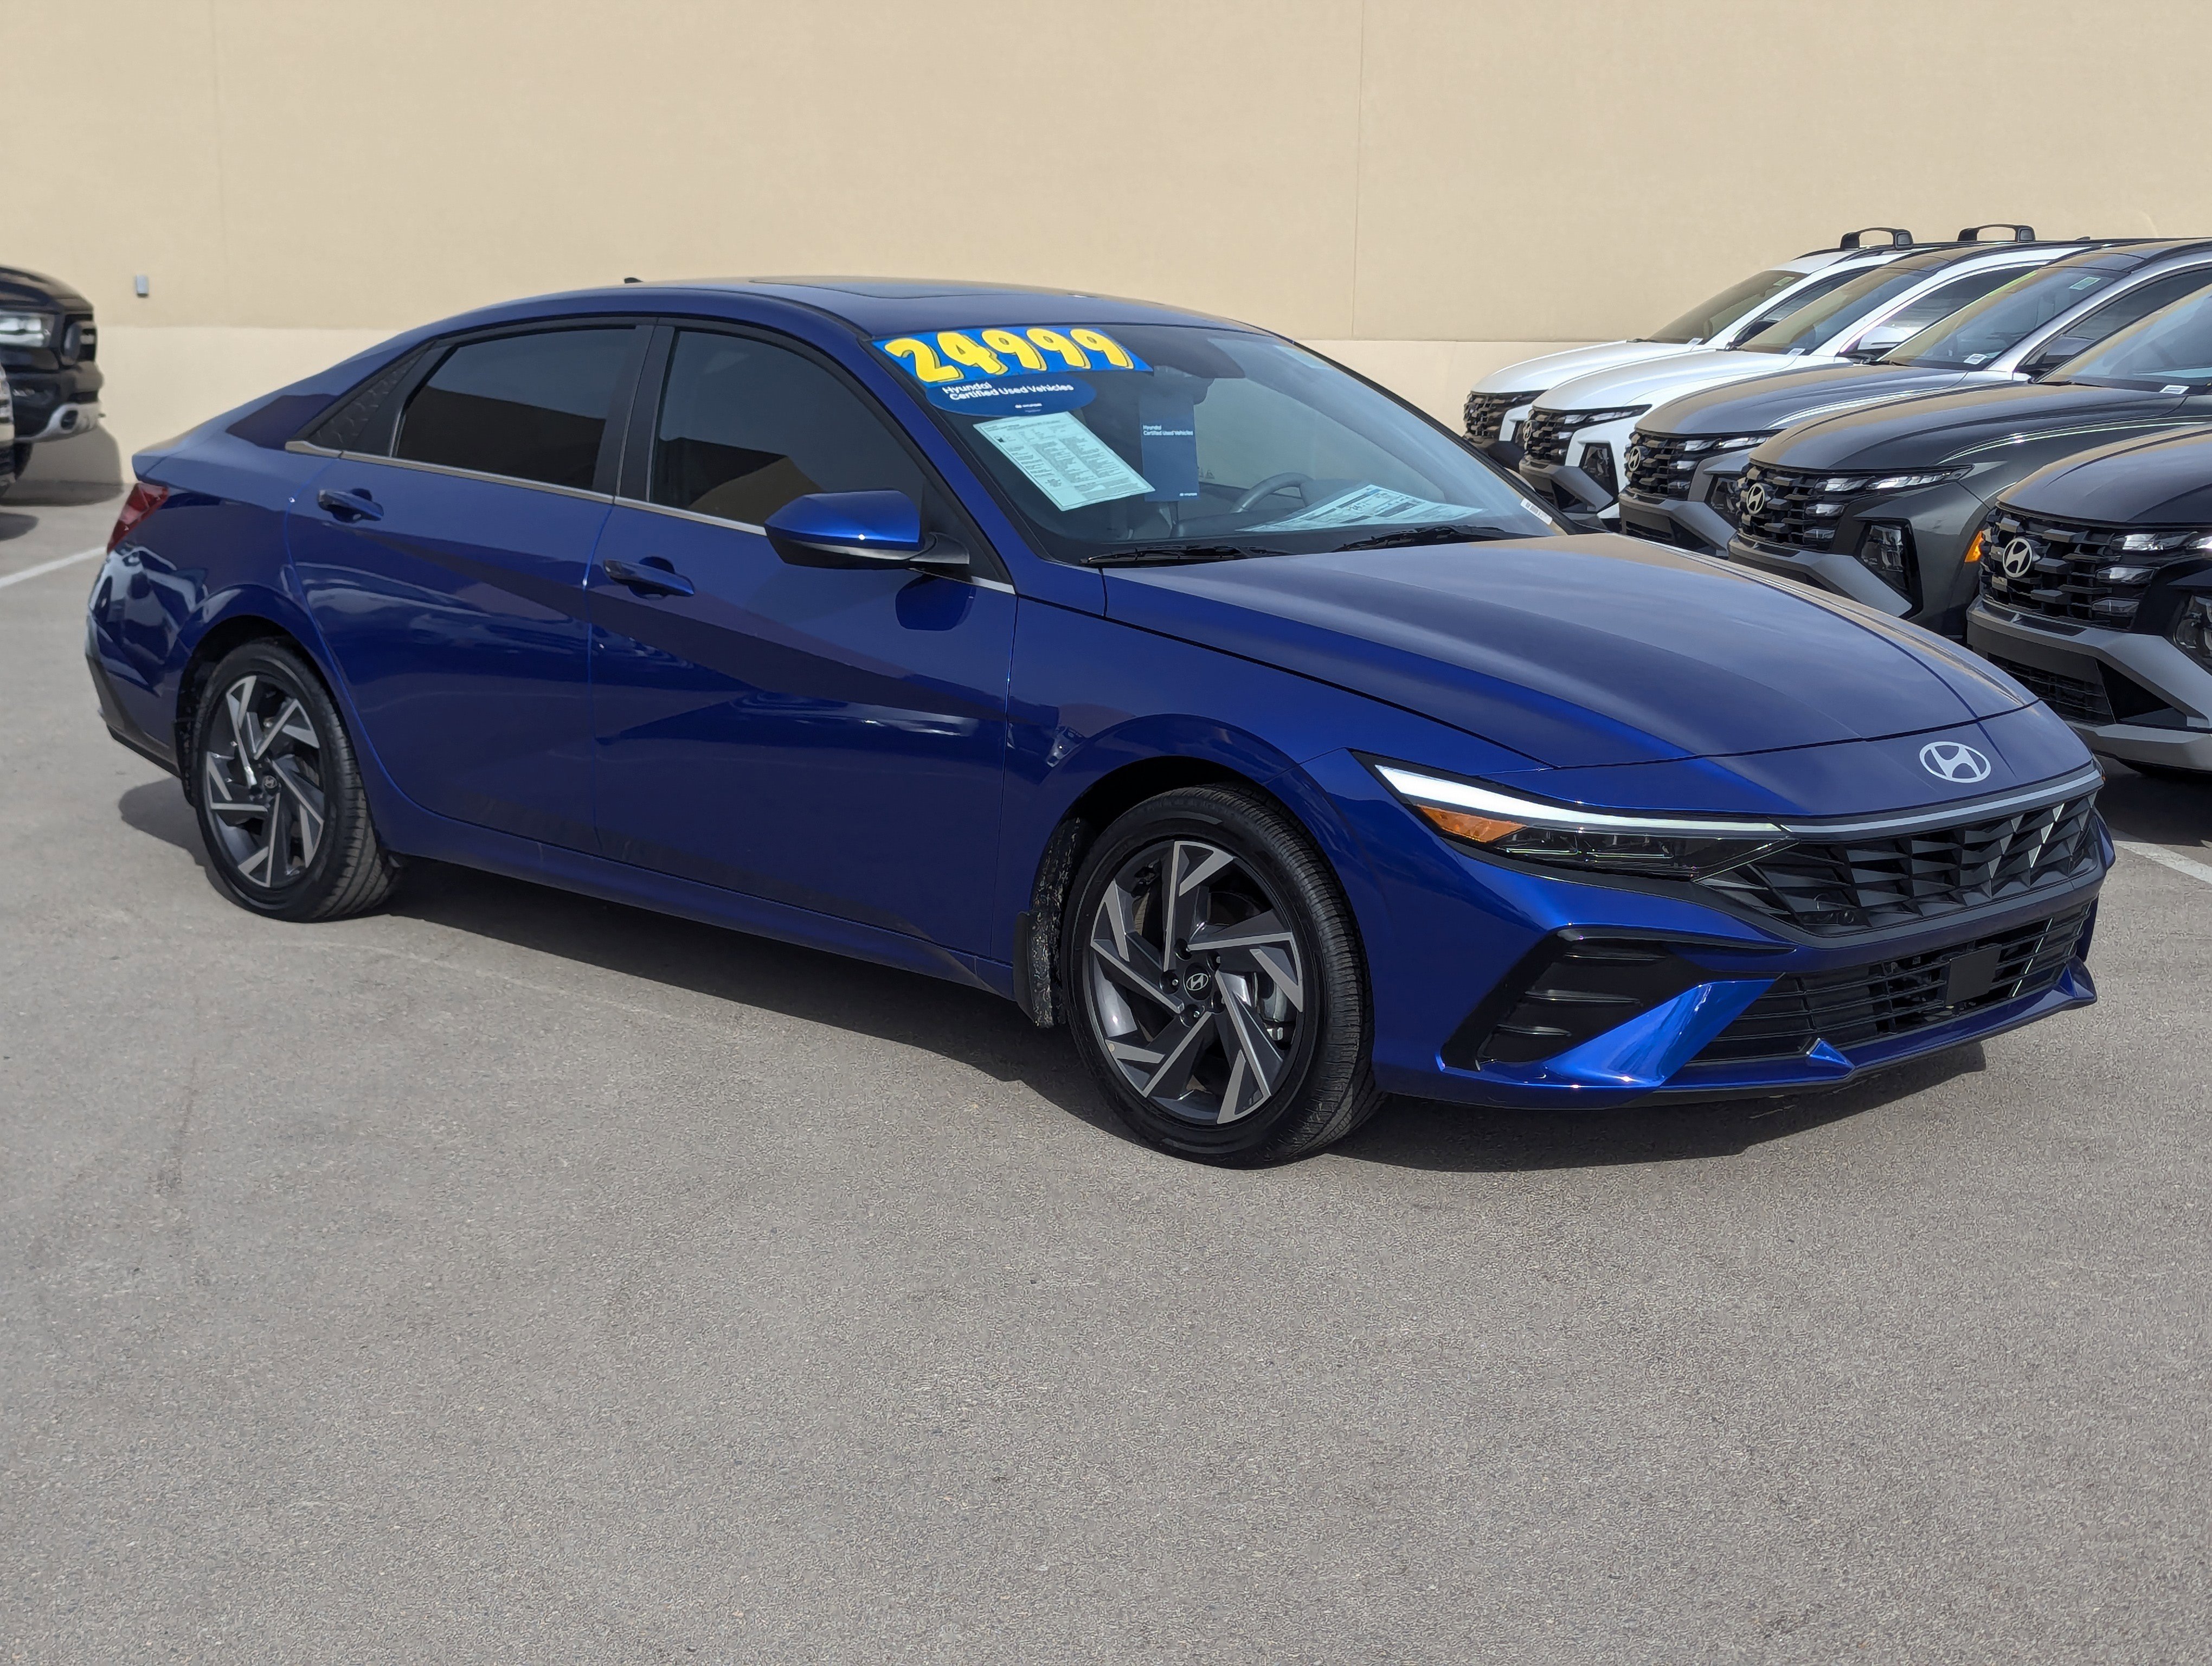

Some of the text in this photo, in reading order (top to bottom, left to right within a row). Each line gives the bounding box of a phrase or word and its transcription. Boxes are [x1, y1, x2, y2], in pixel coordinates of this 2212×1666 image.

[884, 328, 1134, 382] 24999
[942, 381, 992, 394] Hyundai
[949, 384, 1074, 400] Certified Used Vehicles
